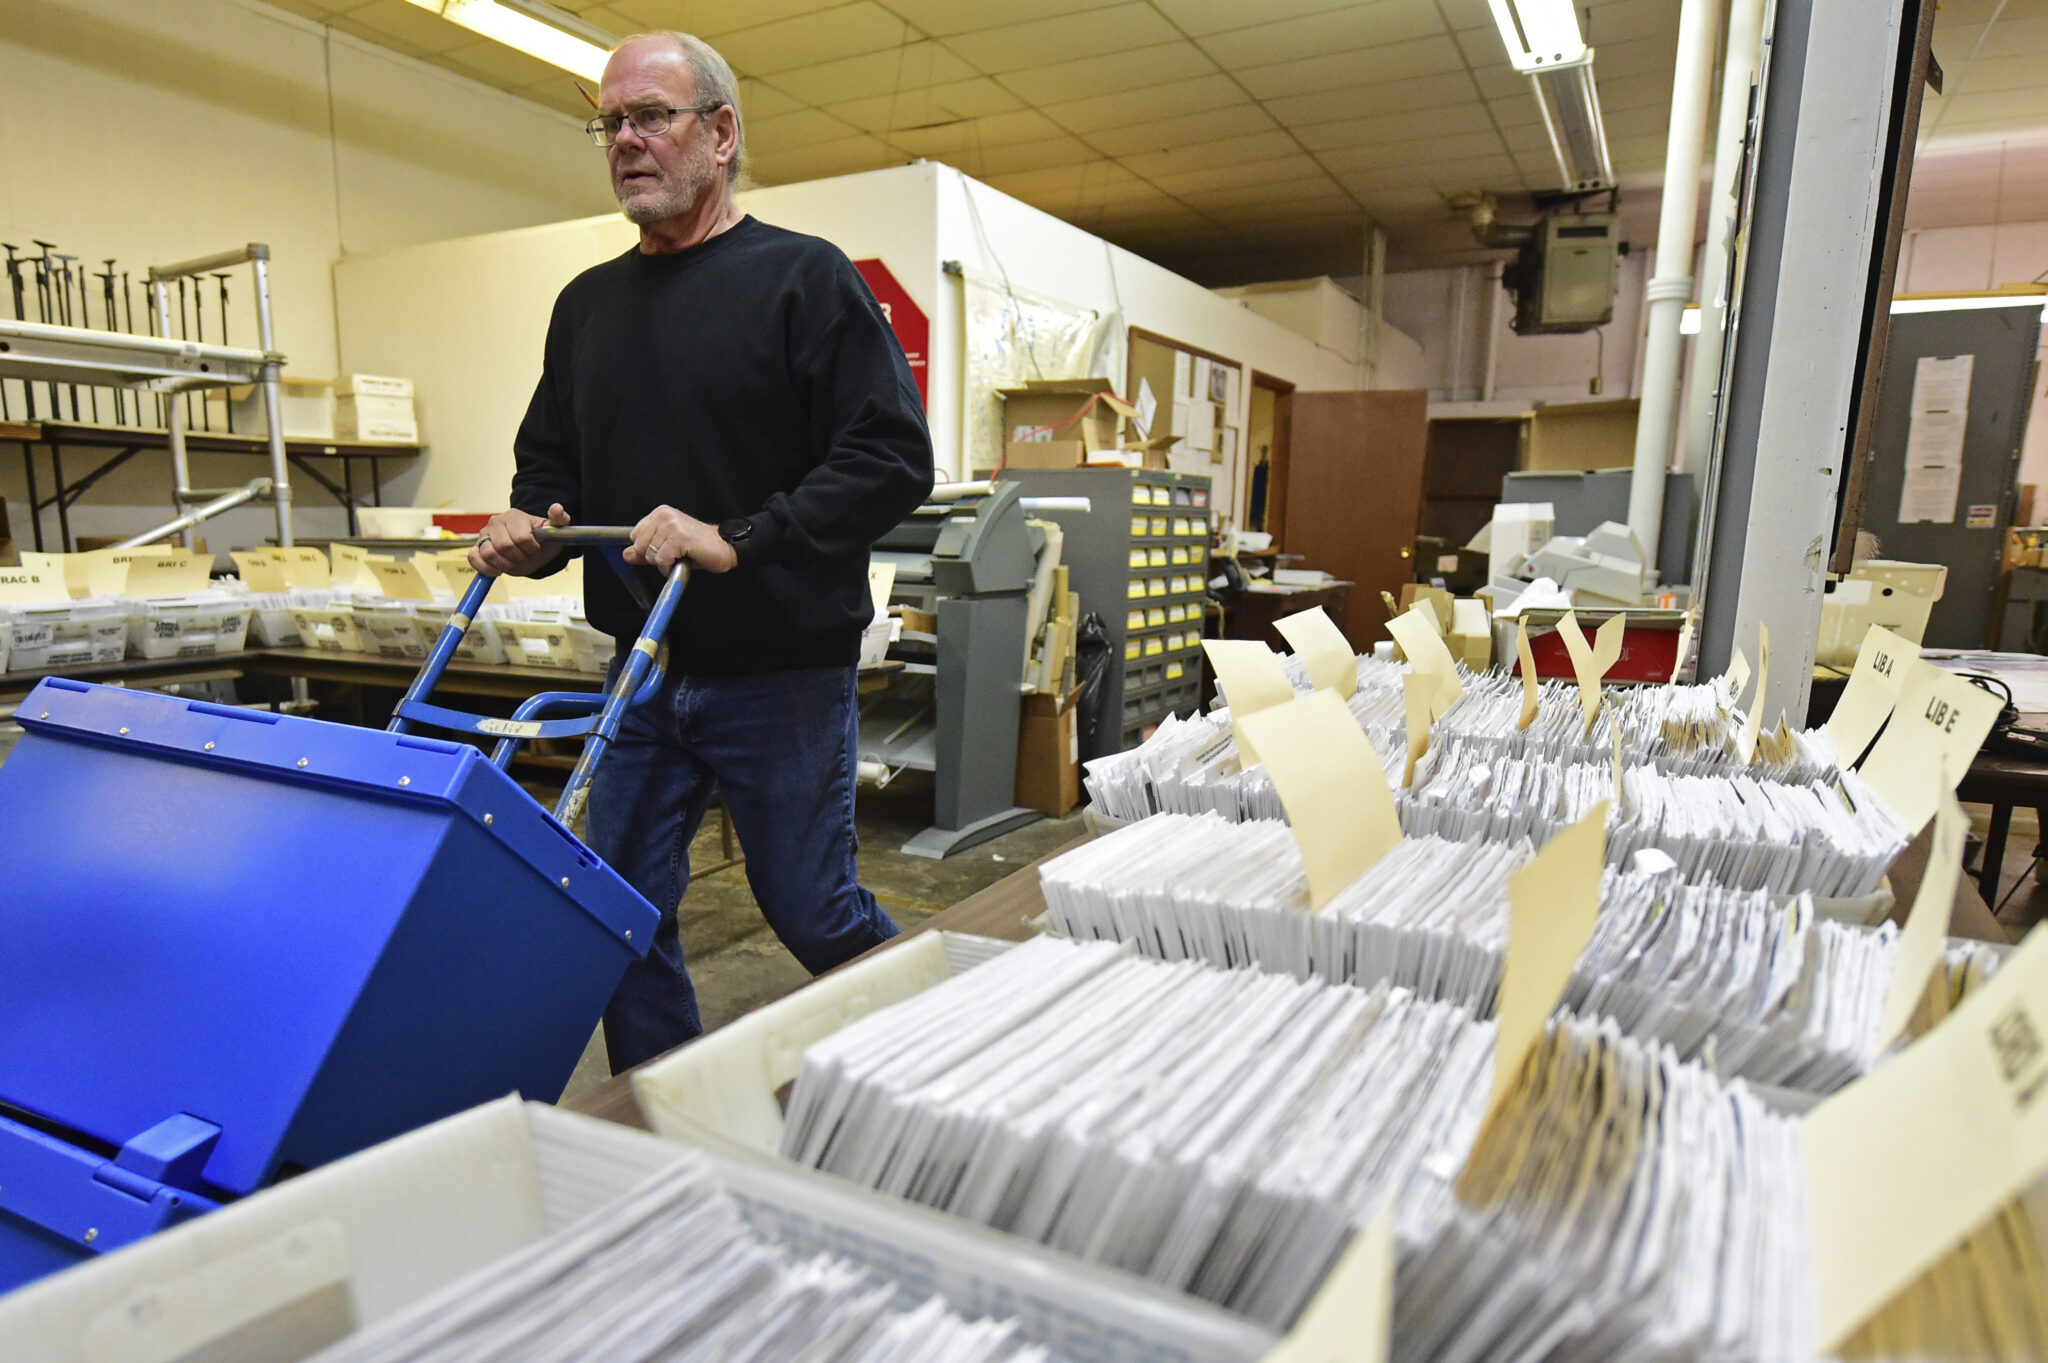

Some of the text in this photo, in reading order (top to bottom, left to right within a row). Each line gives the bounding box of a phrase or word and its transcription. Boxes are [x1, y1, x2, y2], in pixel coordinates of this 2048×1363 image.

[157, 560, 176, 568] BRI
[31, 575, 40, 583] B
[1873, 651, 1894, 677] LIB A
[1925, 695, 1960, 733] LIB E
